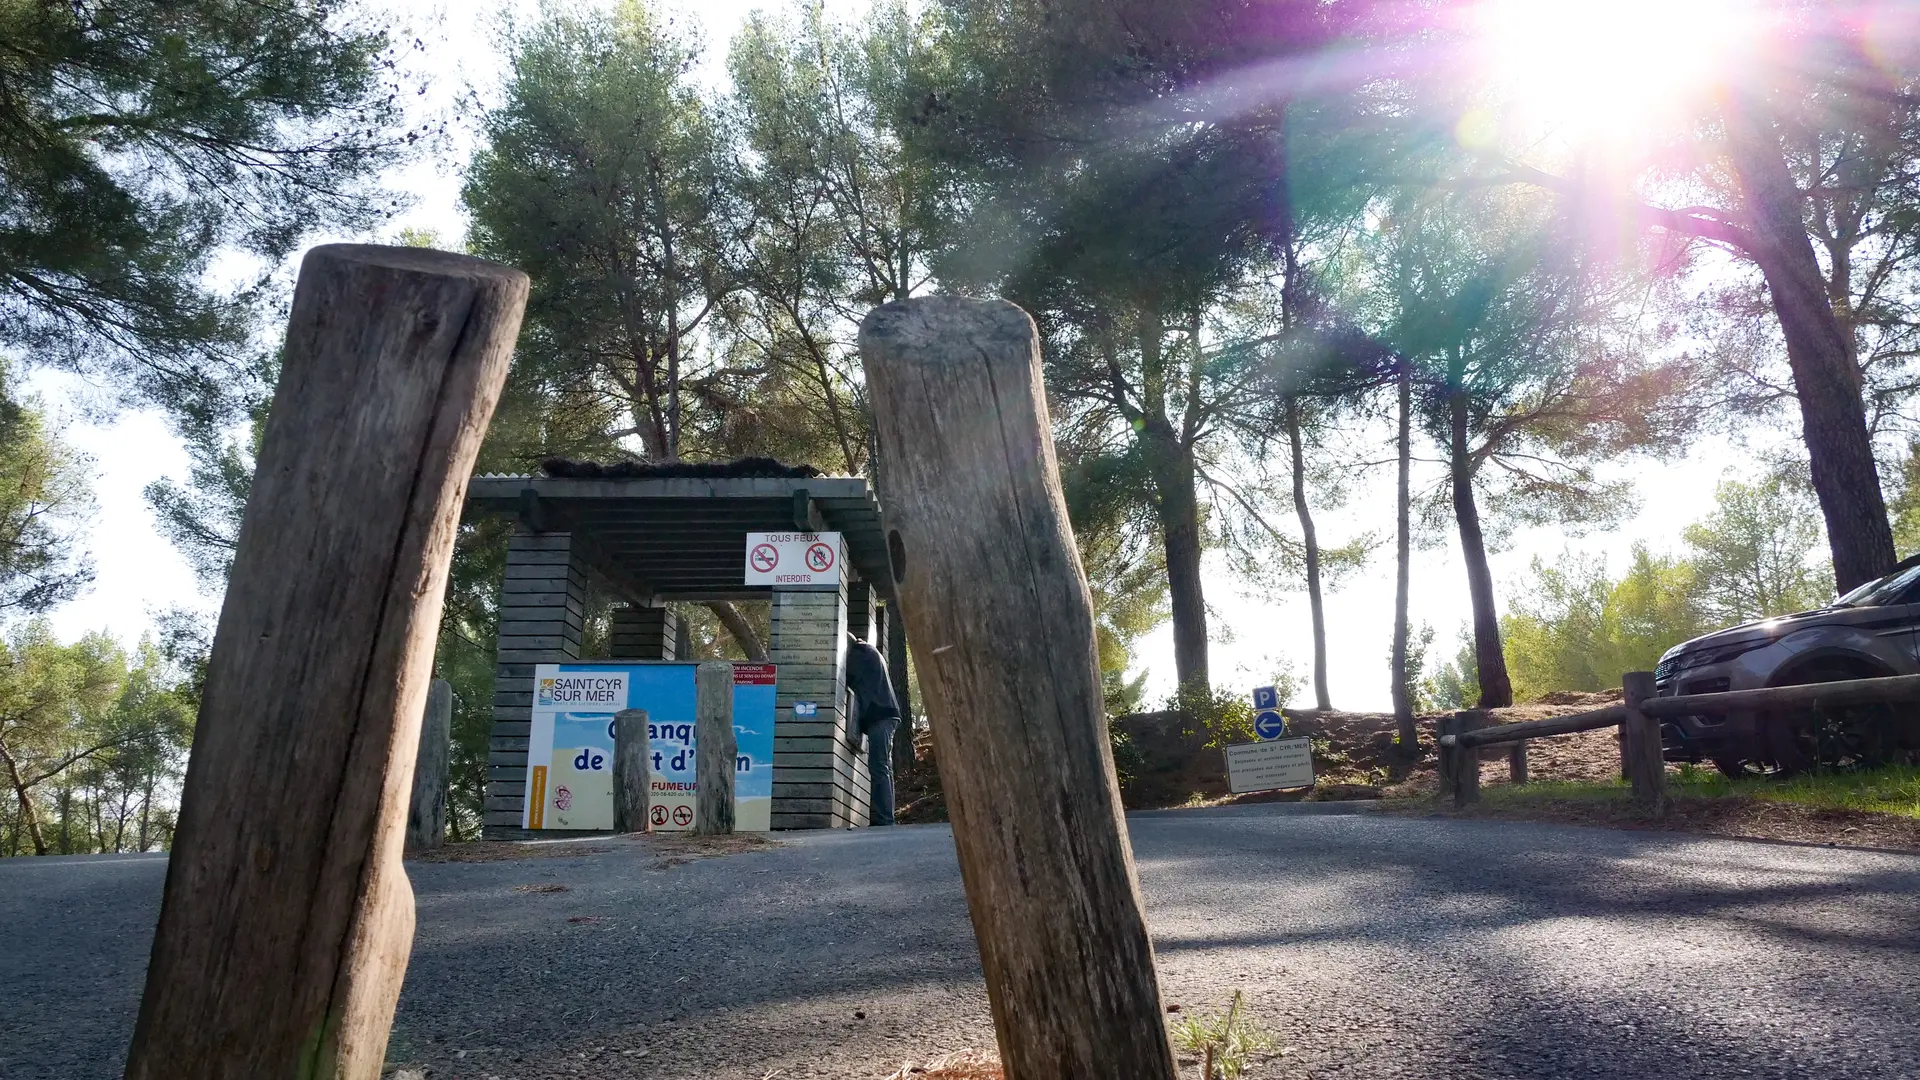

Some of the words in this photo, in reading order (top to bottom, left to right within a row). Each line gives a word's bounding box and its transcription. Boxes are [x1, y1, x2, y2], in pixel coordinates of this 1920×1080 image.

[765, 534, 791, 543] TOUS
[794, 534, 820, 542] FEUX
[775, 574, 811, 583] INTERDITS
[555, 678, 594, 690] SAINT
[595, 678, 622, 690] CYR
[554, 690, 581, 702] SUR
[585, 690, 615, 702] MER
[1259, 691, 1270, 706] P
[1229, 749, 1258, 757] Commune
[574, 748, 604, 771] de
